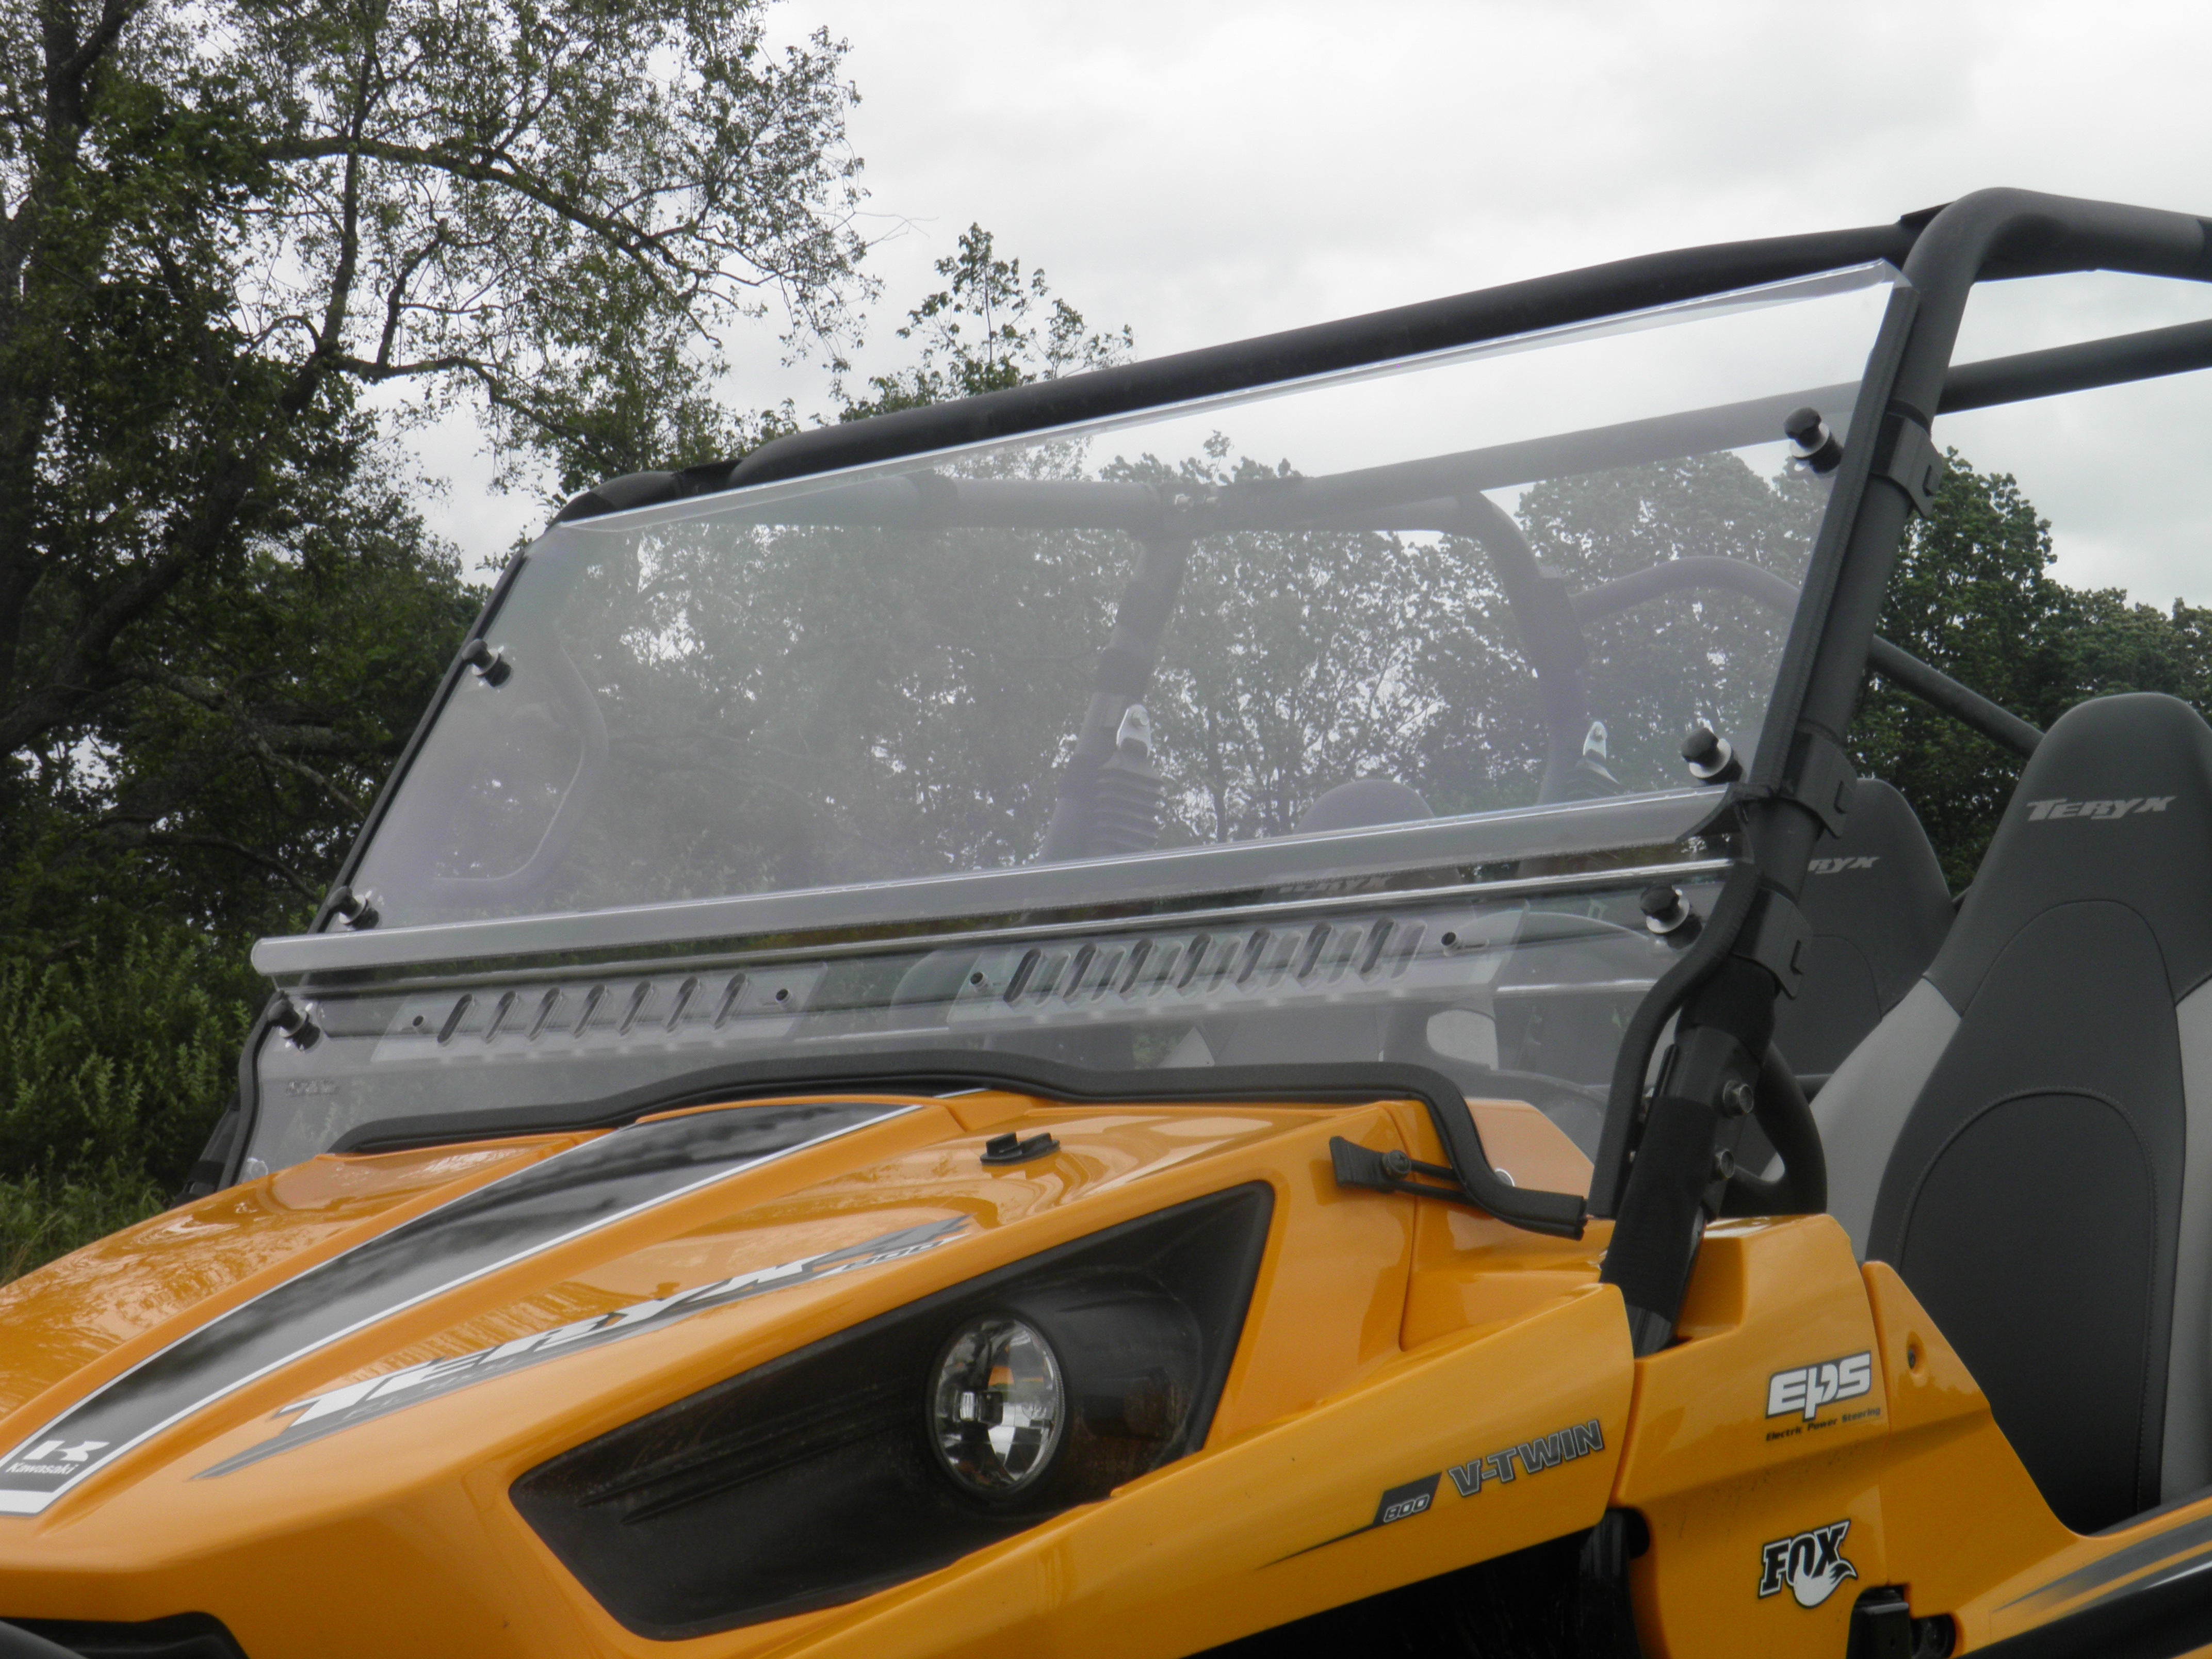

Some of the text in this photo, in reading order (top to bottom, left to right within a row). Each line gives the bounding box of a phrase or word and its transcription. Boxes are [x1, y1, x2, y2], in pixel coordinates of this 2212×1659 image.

[2026, 795, 2177, 822] TERYX
[1807, 856, 1881, 874] RYX
[279, 1250, 837, 1428] TERYX
[1807, 1418, 1838, 1432] Power
[1842, 1407, 1881, 1423] Steering
[5, 1462, 79, 1475] Kawasaki
[1383, 1419, 1605, 1524] 800 V-TWIN
[1759, 1519, 1851, 1599] FOX
